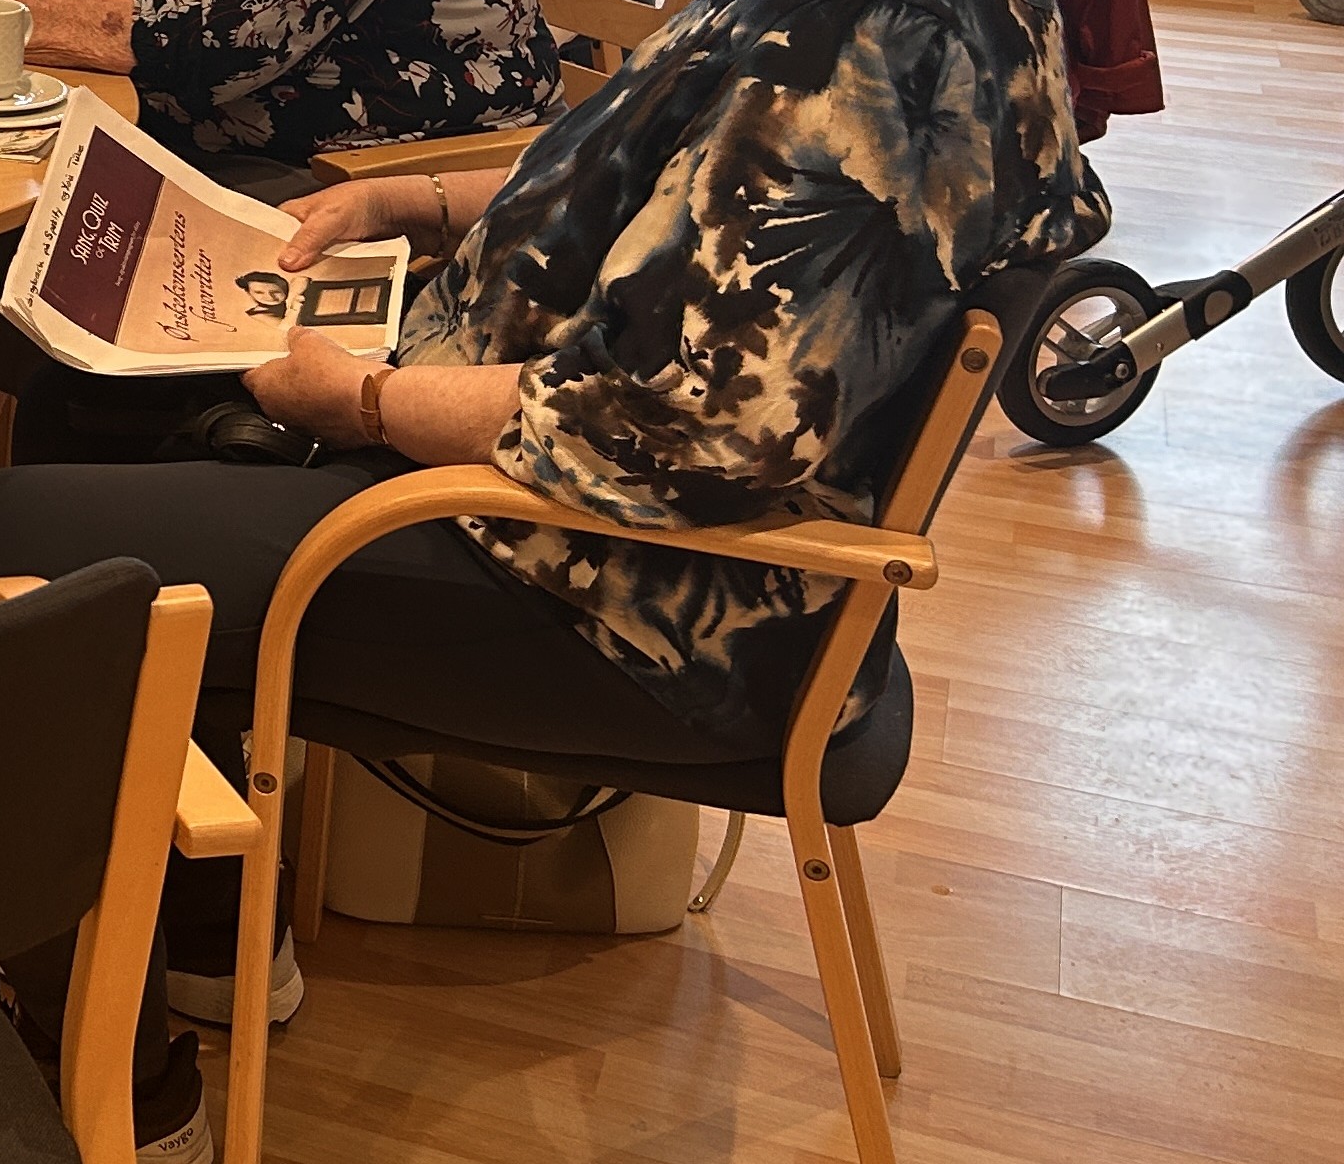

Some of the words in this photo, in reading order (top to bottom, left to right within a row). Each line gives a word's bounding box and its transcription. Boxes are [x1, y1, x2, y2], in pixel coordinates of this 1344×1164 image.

[82, 192, 109, 230] QUIZ
[102, 221, 124, 253] TRIM
[156, 211, 200, 342] Ønskekonsertens
[189, 248, 237, 332] favoritter
